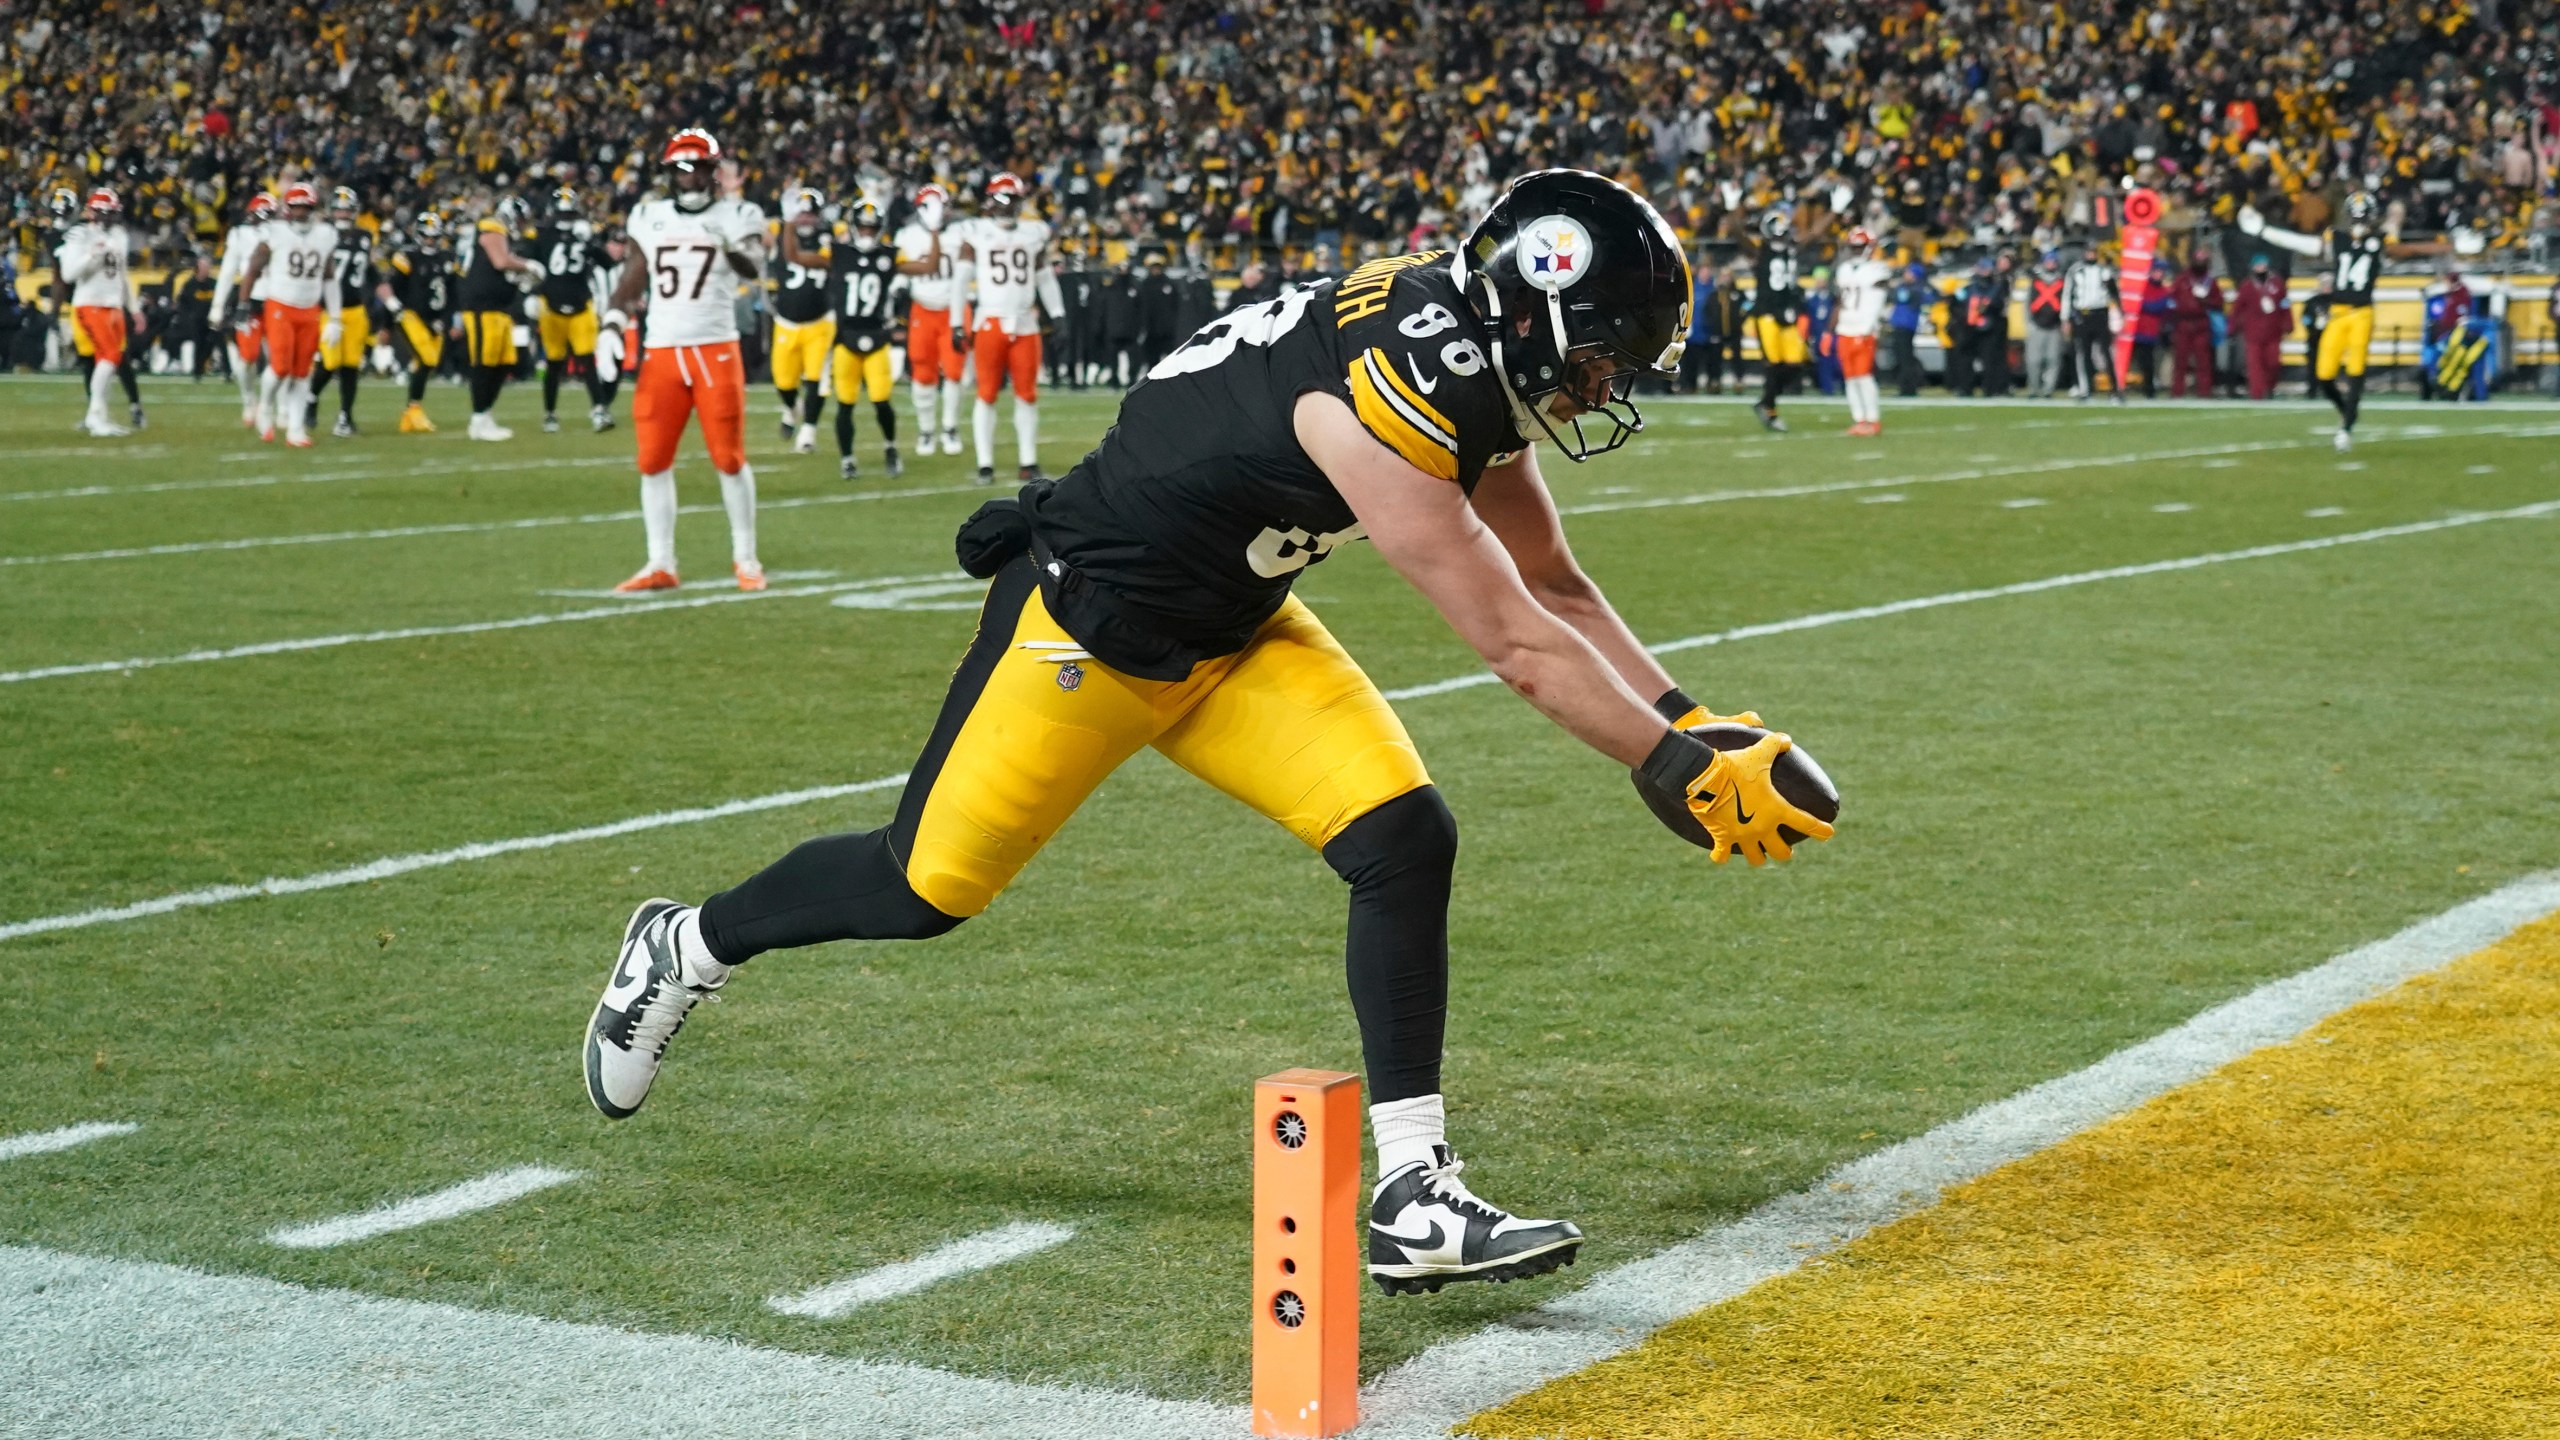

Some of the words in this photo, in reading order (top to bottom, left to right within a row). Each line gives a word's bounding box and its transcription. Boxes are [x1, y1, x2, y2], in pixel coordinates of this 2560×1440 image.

[288, 250, 321, 278] 92
[333, 249, 369, 289] 73
[549, 242, 586, 275] 65
[656, 245, 716, 300] 57
[990, 248, 1029, 285] 59
[2336, 251, 2372, 292] 14
[844, 271, 882, 317] 19
[1397, 302, 1488, 377] 88
[1059, 672, 1078, 688] NFL
